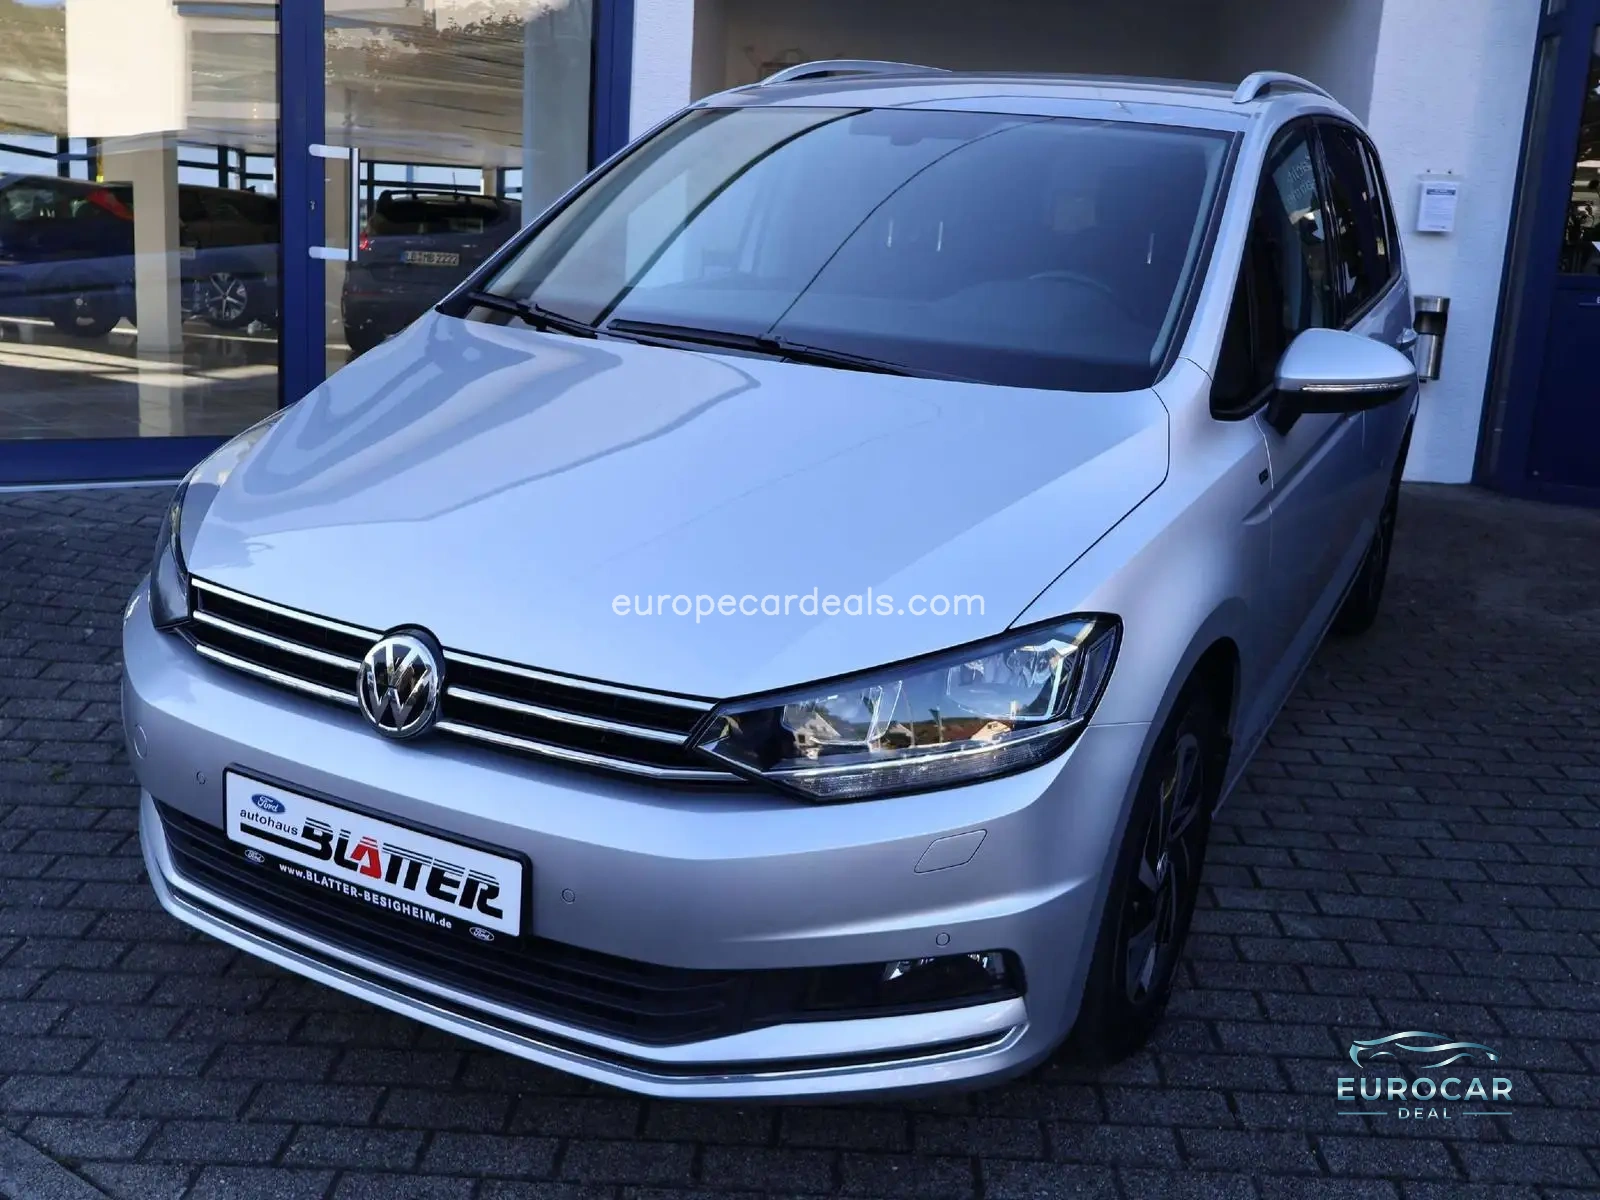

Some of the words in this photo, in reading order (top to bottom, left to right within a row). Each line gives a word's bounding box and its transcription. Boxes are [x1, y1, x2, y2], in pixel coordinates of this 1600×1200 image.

[255, 794, 283, 813] Ford
[239, 808, 299, 837] autohaus
[278, 863, 453, 930] www.BLATTER-BESIGHEIM.de
[471, 927, 492, 940] Ford
